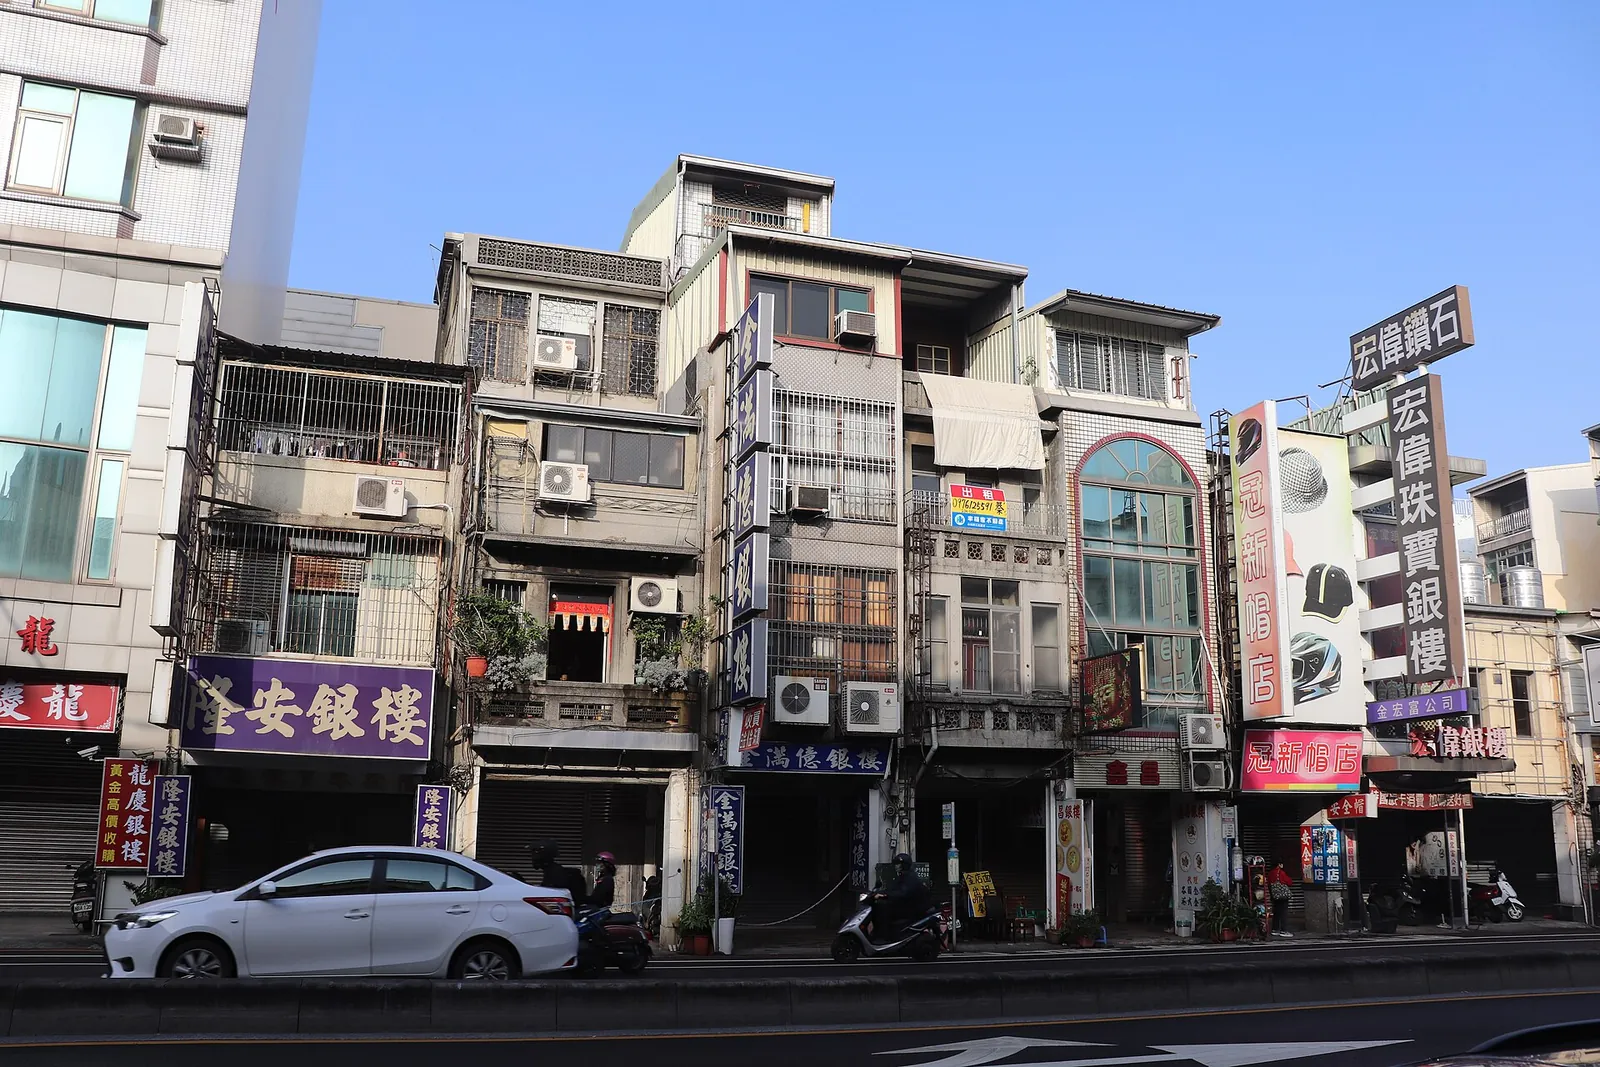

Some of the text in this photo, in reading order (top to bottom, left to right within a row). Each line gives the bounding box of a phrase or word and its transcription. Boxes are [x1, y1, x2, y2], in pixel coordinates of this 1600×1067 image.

[1353, 293, 1460, 382] 宏偉鑽石
[1392, 387, 1449, 676] 宏偉珠寶銀樓
[1238, 474, 1275, 707] 冠新帽店
[17, 614, 59, 657] 龍
[187, 674, 427, 746] 隆安銀樓
[1376, 695, 1453, 720] 金宏富公司
[1247, 742, 1358, 774] 冠新帽店
[102, 764, 123, 862] 黃金高價收購
[121, 764, 151, 863] 龍慶銀樓
[155, 778, 184, 873] 隆安銀樓
[1330, 798, 1365, 816] 安全帽
[1301, 829, 1313, 879] 安全帽
